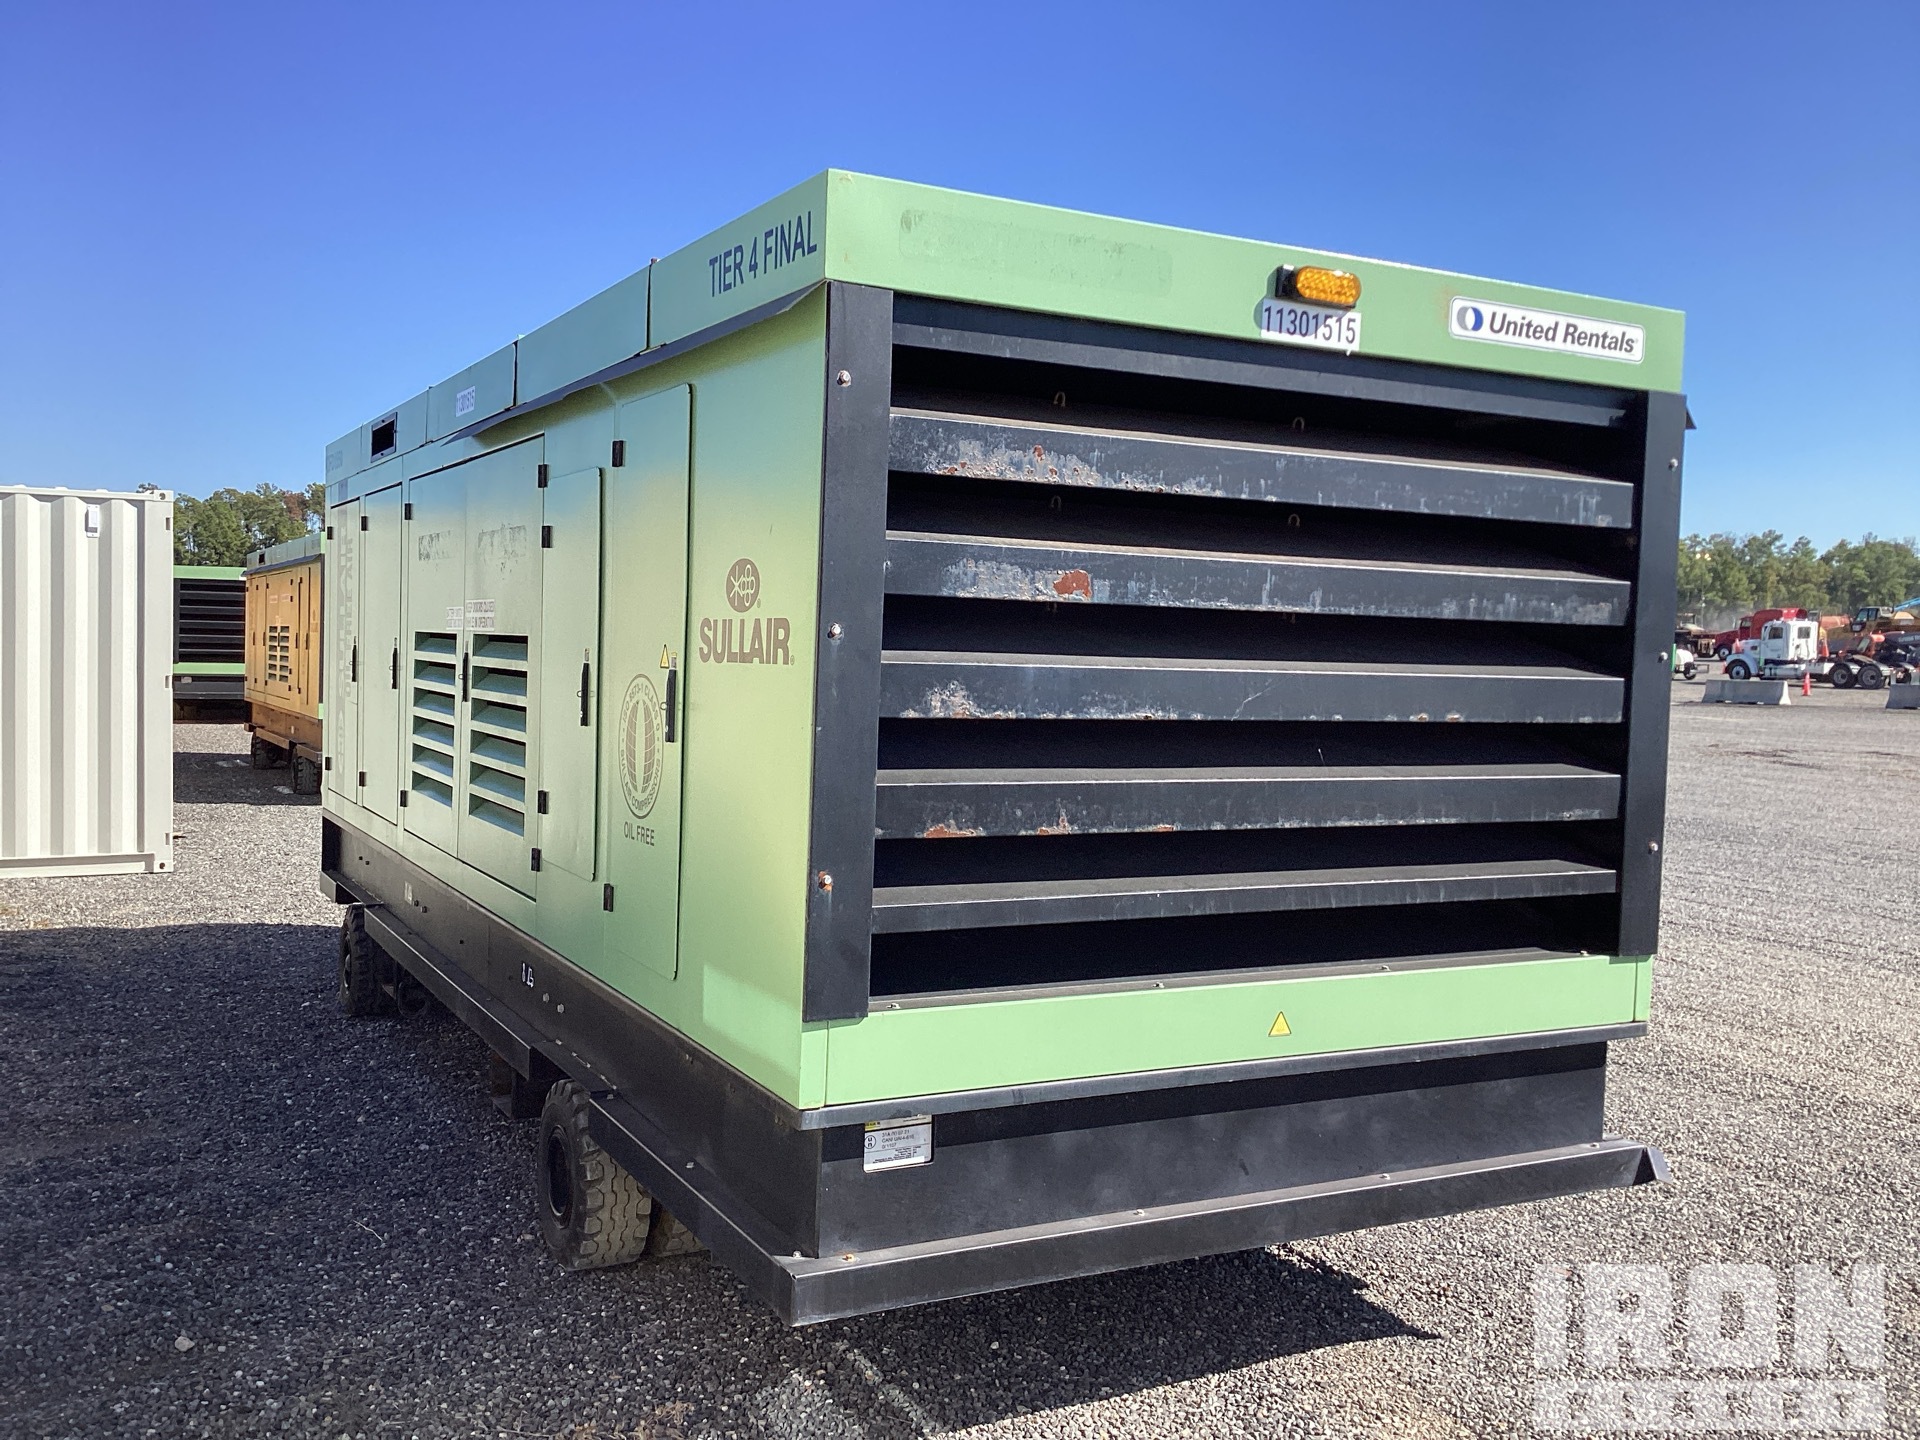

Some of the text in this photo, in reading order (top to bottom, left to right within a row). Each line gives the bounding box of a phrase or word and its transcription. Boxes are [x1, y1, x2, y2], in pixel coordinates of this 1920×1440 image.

[708, 210, 817, 297] TIER 4 FINAL
[1264, 305, 1357, 344] 11301515
[1489, 311, 1635, 354] United Rentals
[699, 617, 790, 665] SULLAIR
[624, 821, 655, 846] OIL FREE
